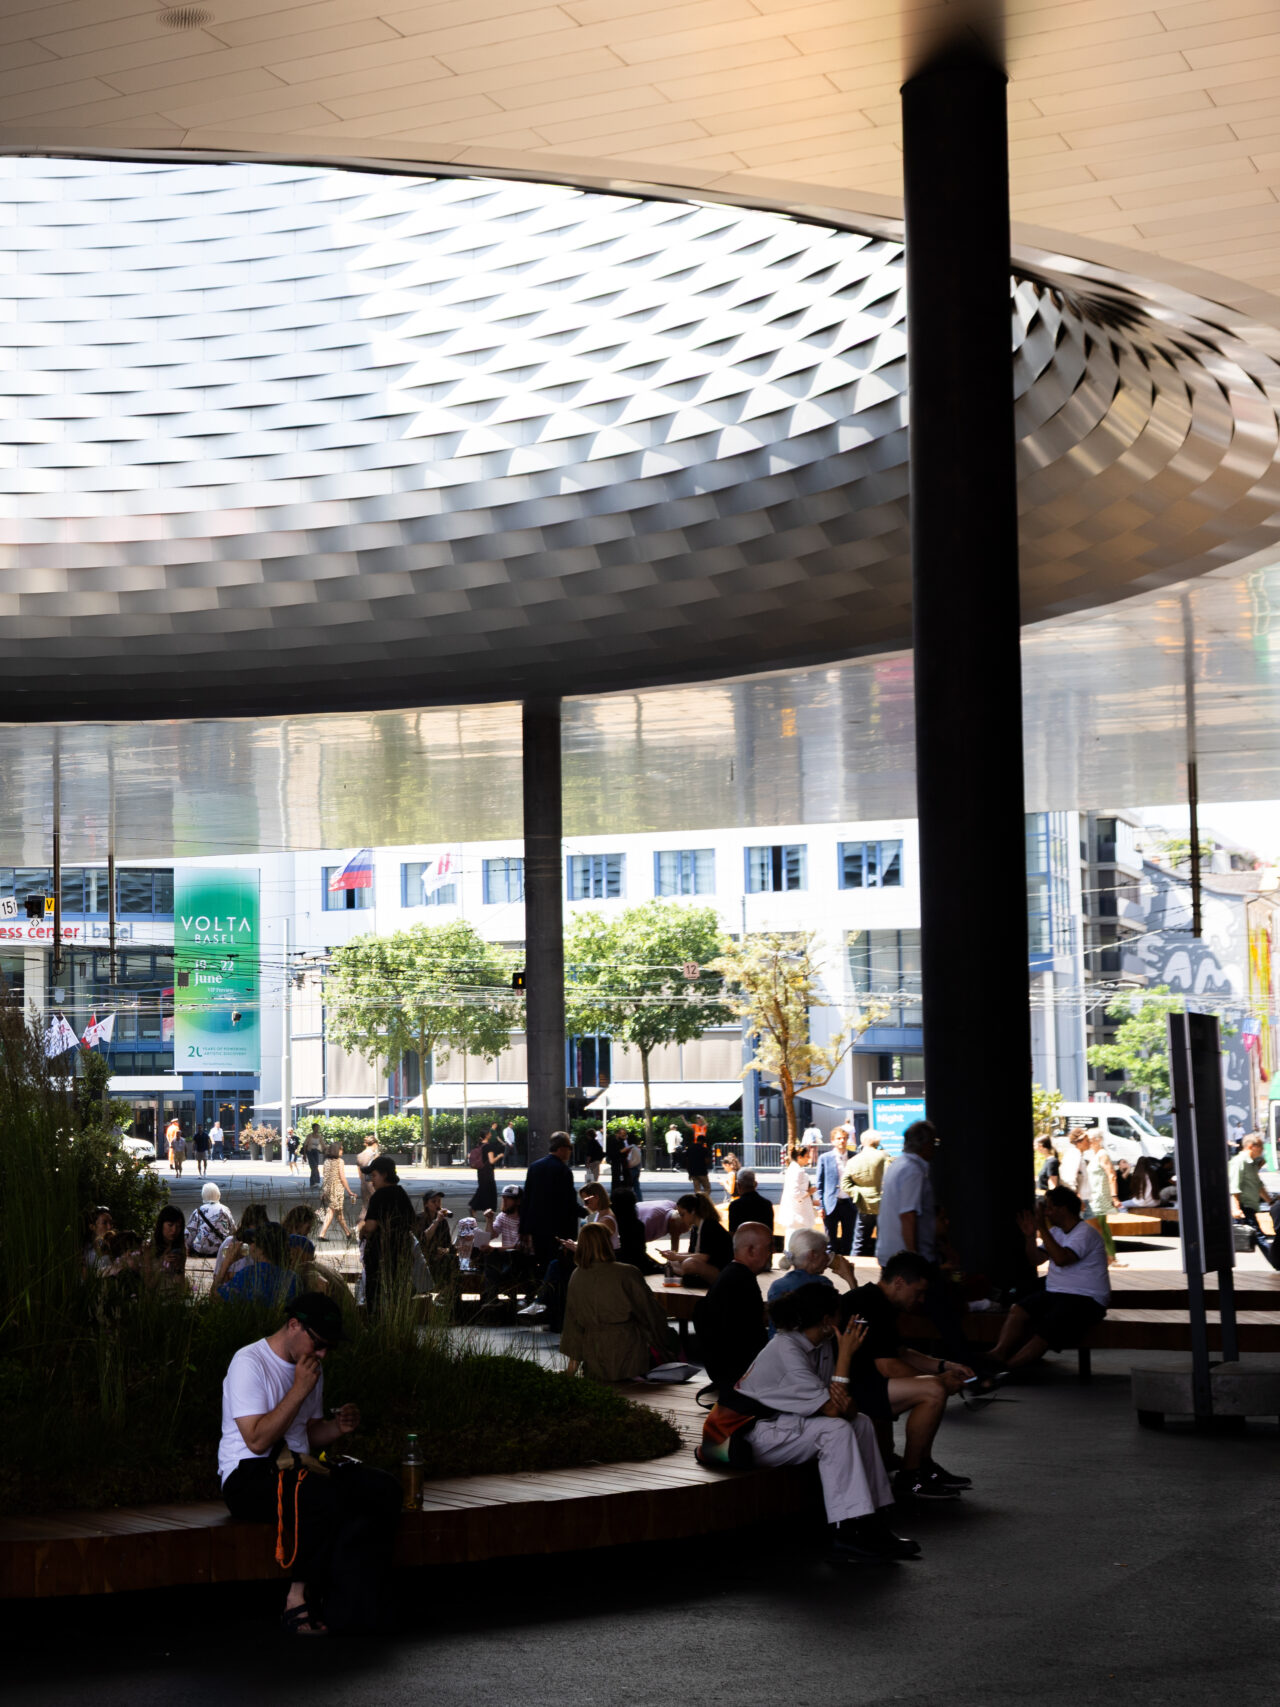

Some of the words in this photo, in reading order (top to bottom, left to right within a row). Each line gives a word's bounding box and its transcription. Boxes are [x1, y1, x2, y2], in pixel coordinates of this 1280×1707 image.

[46, 900, 53, 910] V
[181, 916, 251, 932] VOLTA
[28, 927, 80, 939] cener
[92, 922, 133, 939] bael
[194, 934, 236, 944] BASEL
[220, 960, 234, 971] 22
[686, 965, 697, 975] 12
[194, 972, 223, 986] June
[876, 1103, 924, 1112] Unlimited
[877, 1114, 905, 1125] Night
